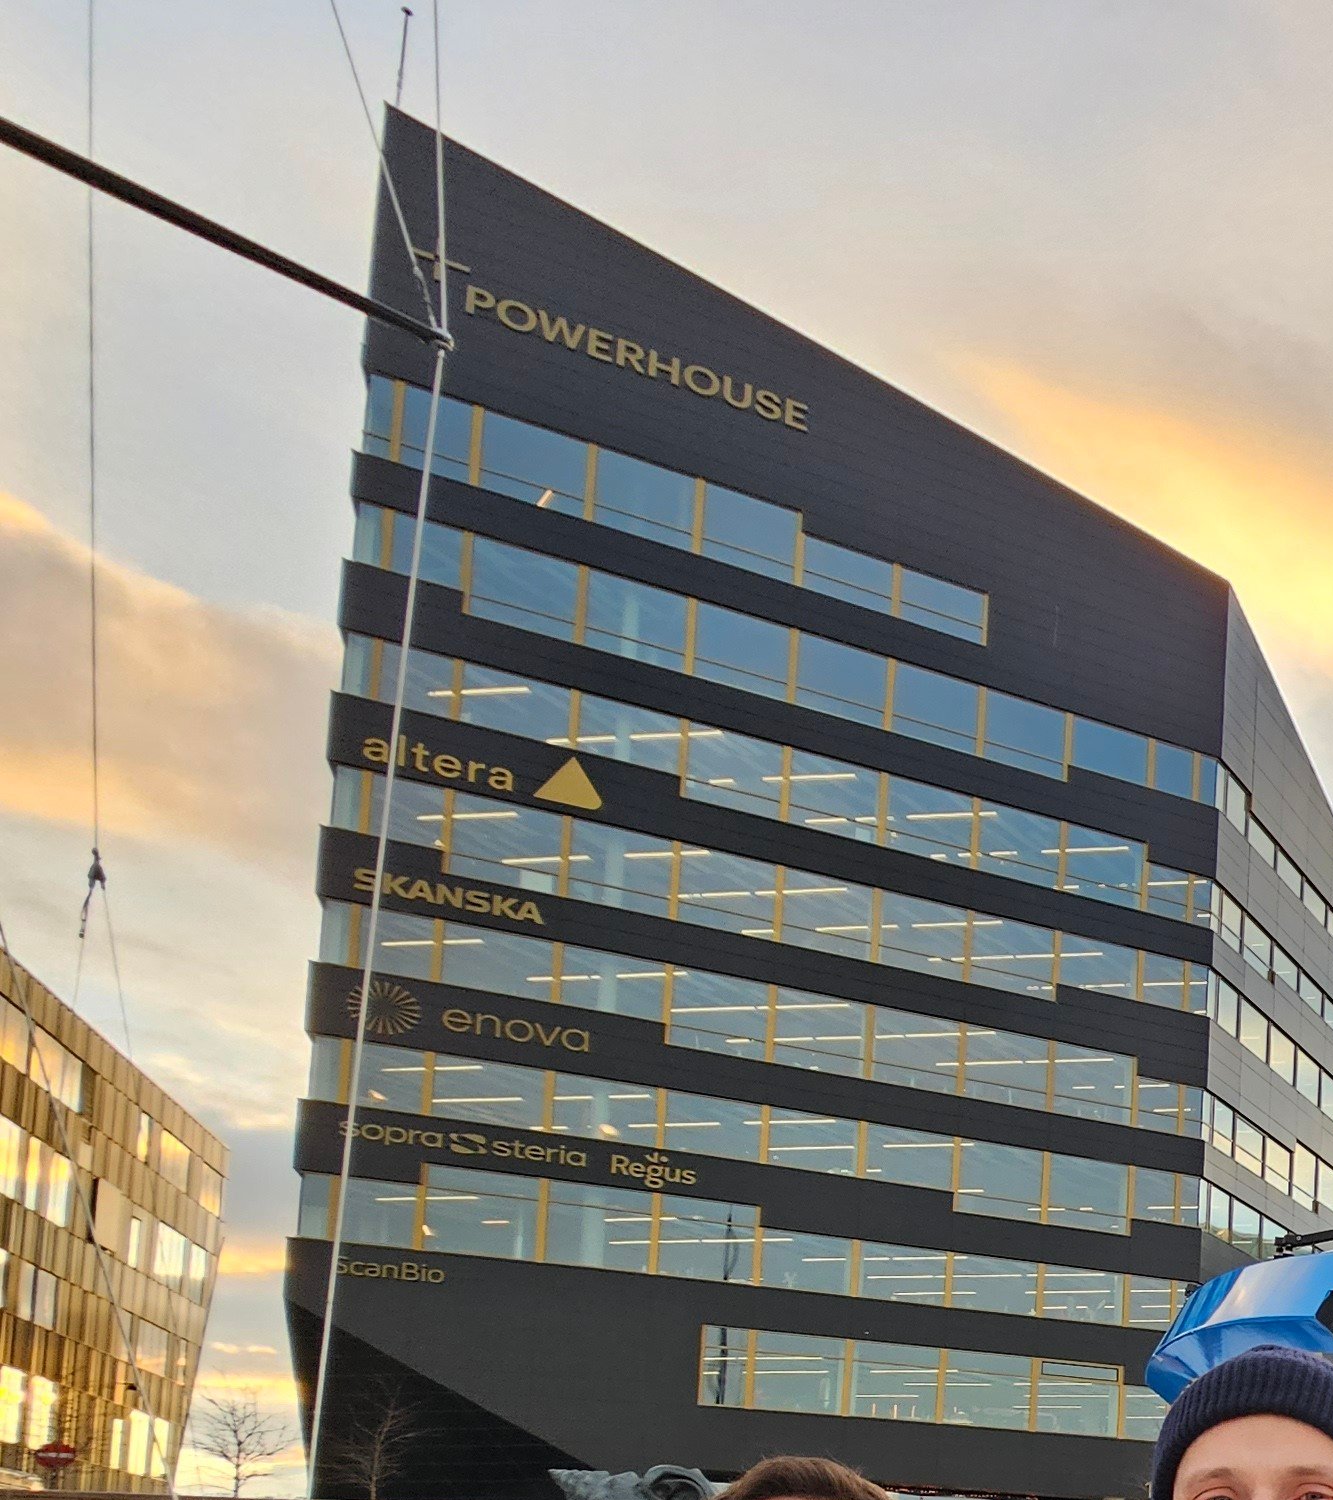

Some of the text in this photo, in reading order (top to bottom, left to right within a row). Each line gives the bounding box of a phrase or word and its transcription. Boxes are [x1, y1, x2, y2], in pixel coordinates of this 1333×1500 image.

[464, 284, 810, 433] POWERHOUSE
[362, 734, 516, 793] altera
[353, 867, 546, 926] SKANSKA
[441, 1007, 590, 1053] enova
[338, 1118, 588, 1169] sopra steria
[609, 1152, 698, 1189] Regus
[336, 1255, 446, 1284] ScanBio
